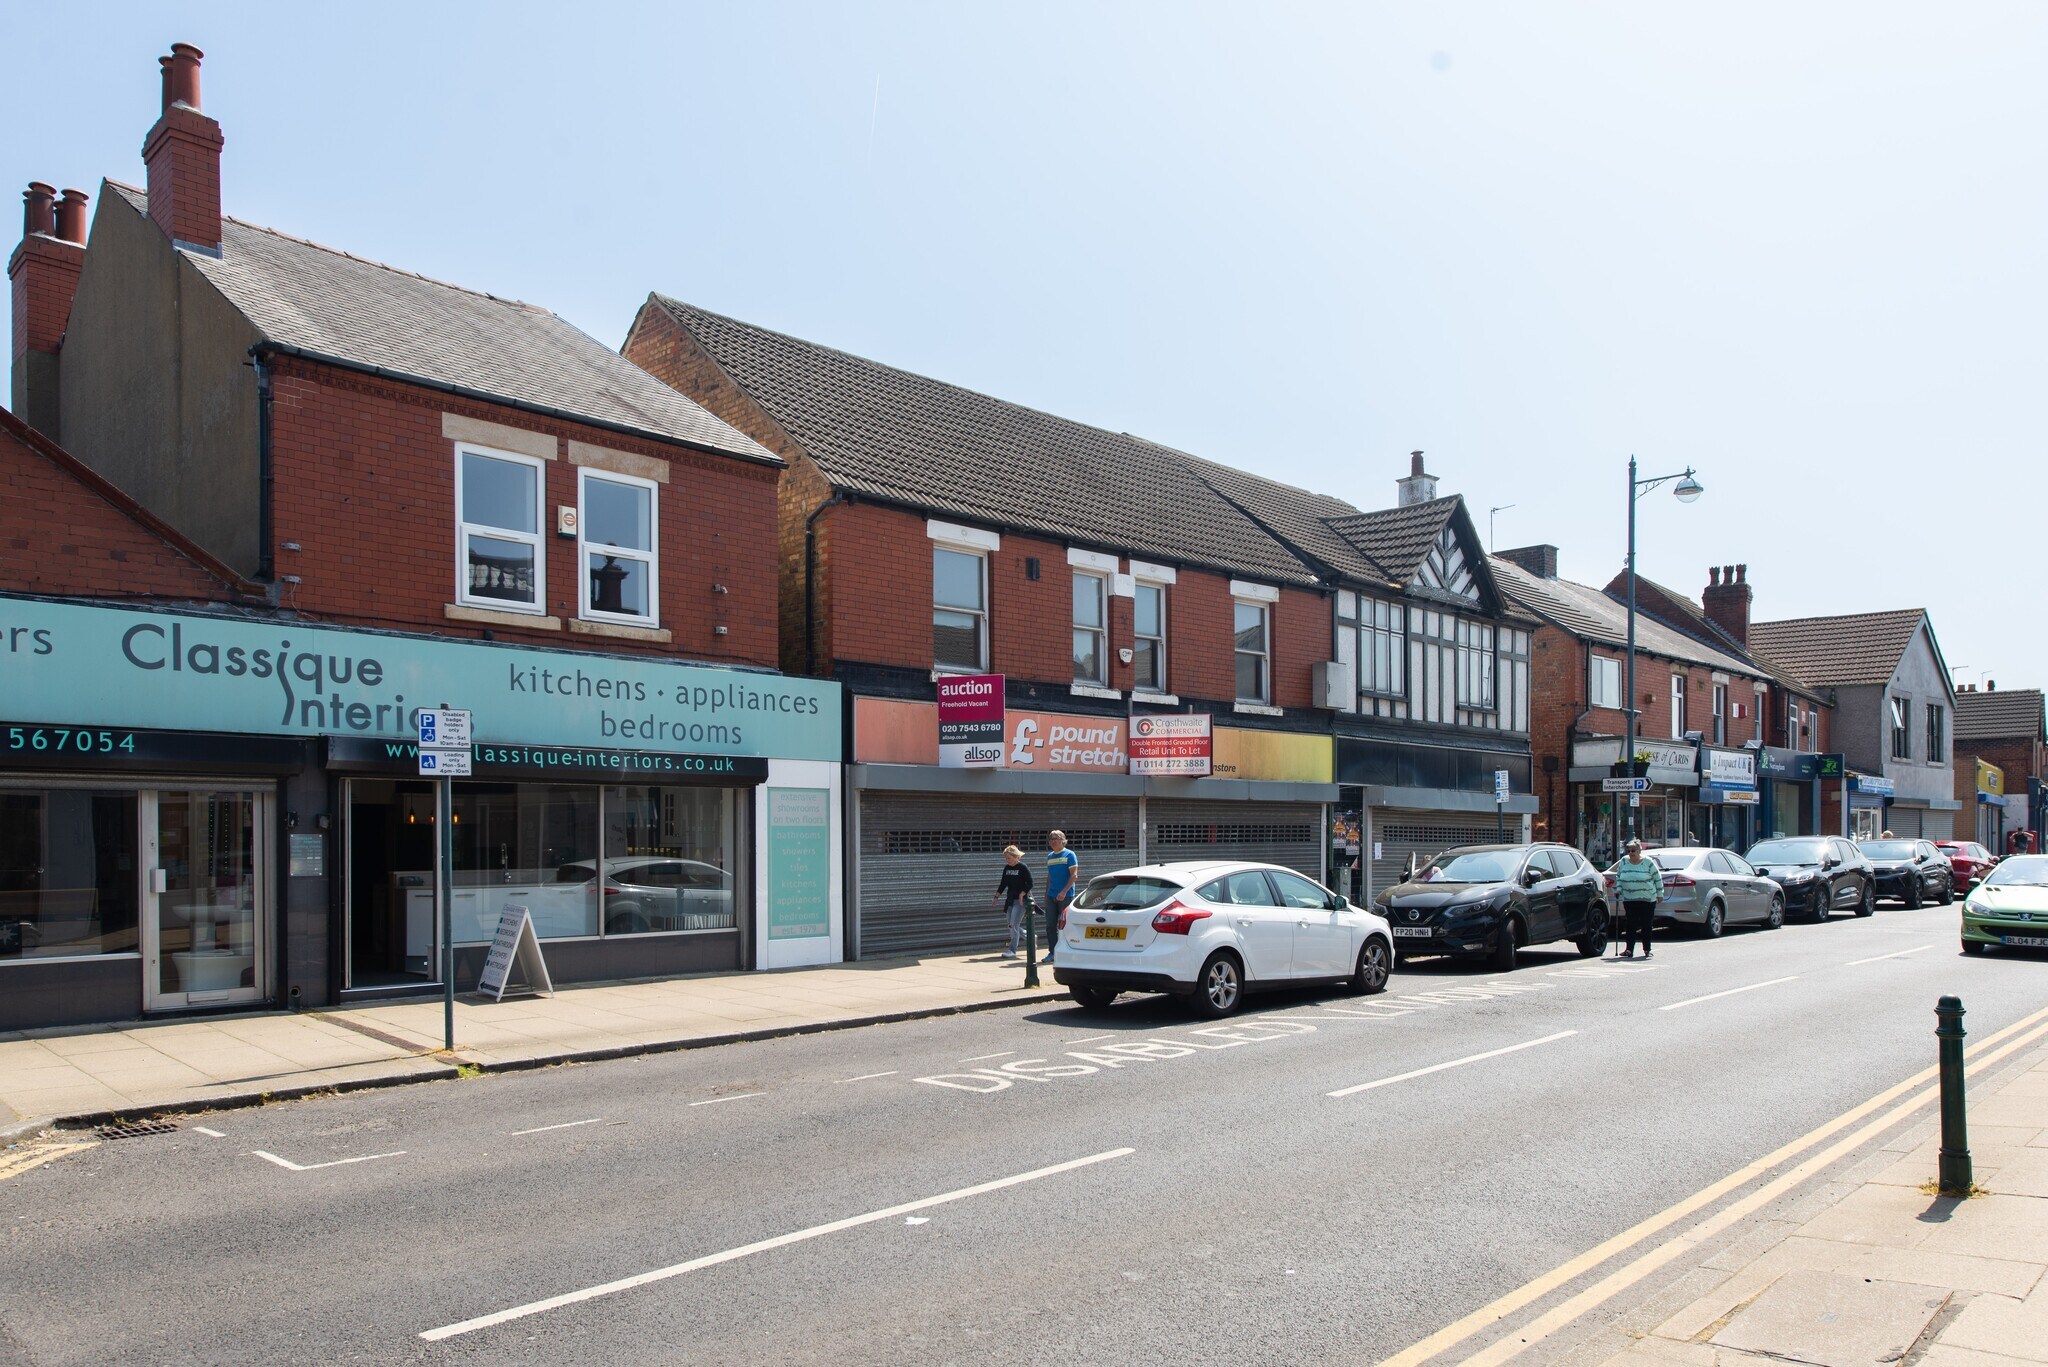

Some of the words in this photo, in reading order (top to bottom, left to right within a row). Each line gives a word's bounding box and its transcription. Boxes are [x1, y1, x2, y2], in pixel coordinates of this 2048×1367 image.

[0, 627, 53, 655] rs
[122, 623, 383, 695] Classique
[509, 663, 647, 701] kitchens
[676, 683, 819, 714] appliances
[941, 680, 993, 696] auction
[279, 693, 474, 734] Interi
[601, 711, 743, 744] bedrooms
[942, 725, 957, 733] 020
[959, 724, 979, 732] 7543
[980, 723, 1001, 731] 6780
[1155, 718, 1203, 728] Crosthwaite
[1155, 727, 1202, 735] COMMERCIAL
[10, 728, 135, 752] 567054
[1049, 725, 1119, 745] pound
[1173, 738, 1194, 746] Ground
[964, 746, 1001, 762] allsop
[1139, 746, 1160, 755] Retail
[1161, 747, 1176, 755] Unit
[1178, 746, 1187, 754] To
[1188, 746, 1201, 754] Let
[1136, 760, 1142, 768] T
[1143, 760, 1163, 768] 0114
[1165, 760, 1181, 768] 272
[1183, 759, 1205, 768] 3888
[1105, 928, 1120, 938] EJA
[1395, 928, 1414, 936] FP20
[1414, 928, 1429, 936] HNH
[2006, 937, 2029, 945] BL04
[913, 1022, 1318, 1093] DISABLED
